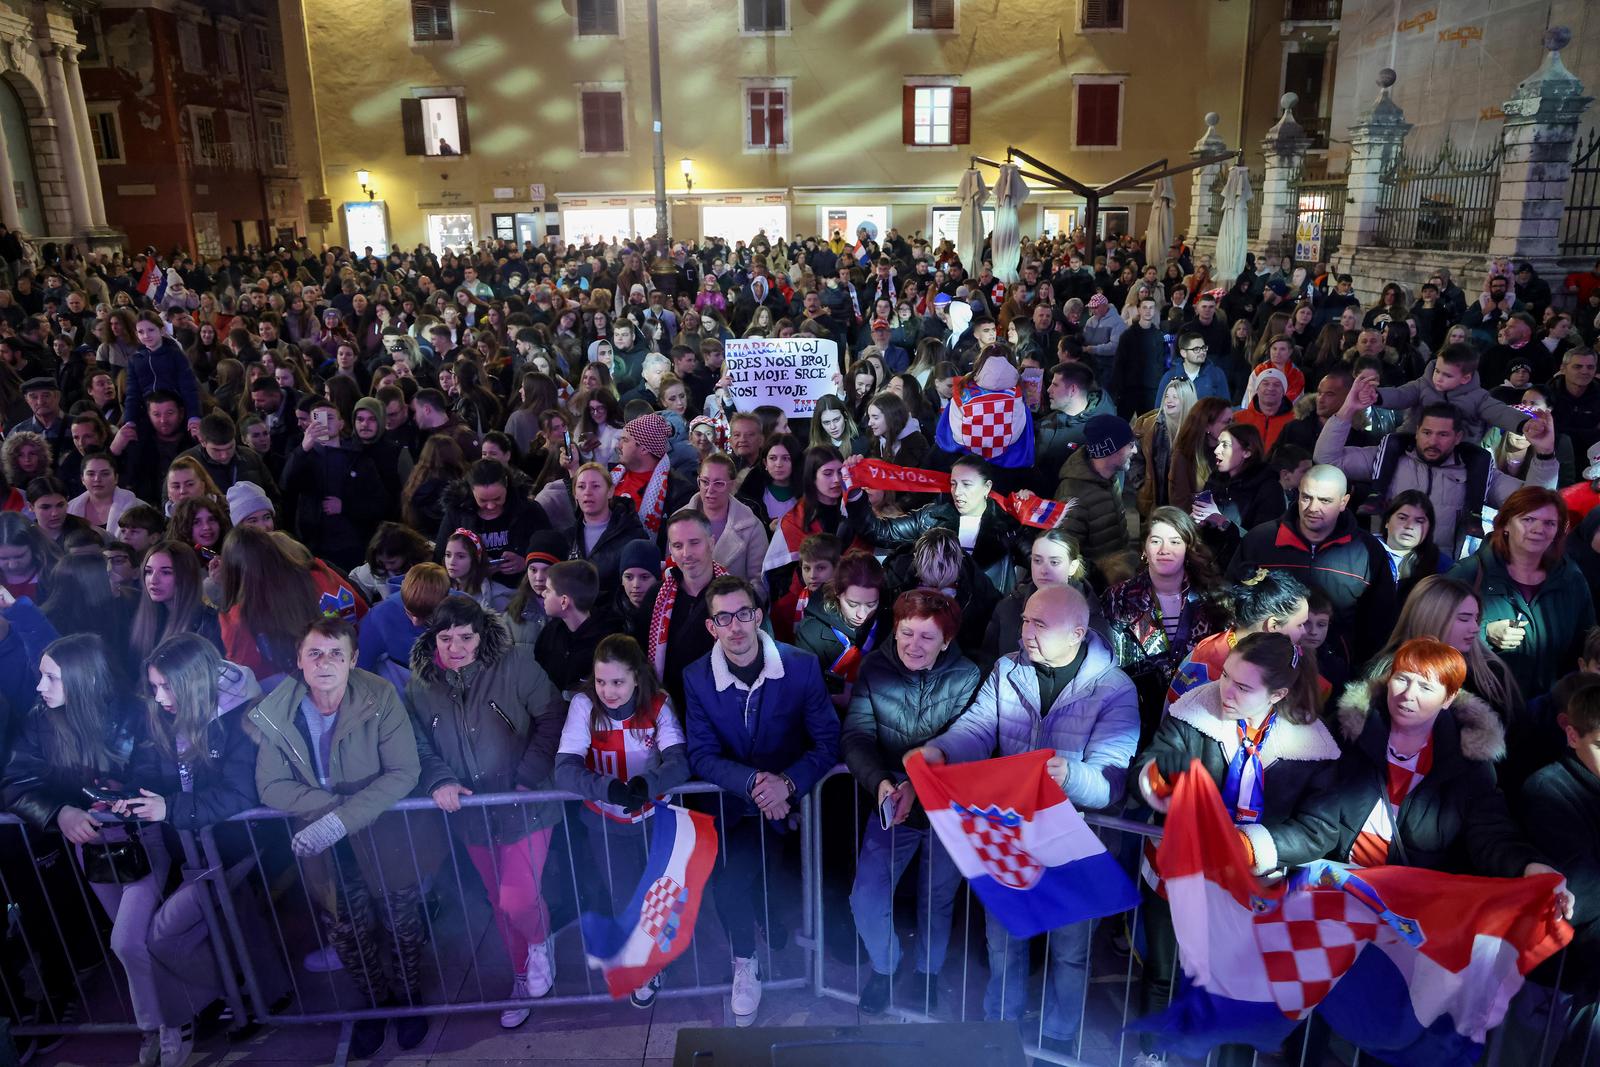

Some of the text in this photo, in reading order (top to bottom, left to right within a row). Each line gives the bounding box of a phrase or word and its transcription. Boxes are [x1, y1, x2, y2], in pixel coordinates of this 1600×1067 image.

[785, 340, 819, 354] TVOJ
[727, 354, 831, 370] DRES NOSI BROJ,
[754, 370, 789, 382] MOJE
[794, 368, 827, 380] SRCE
[729, 385, 808, 397] NOSI TVOJE
[592, 748, 619, 779] 10
